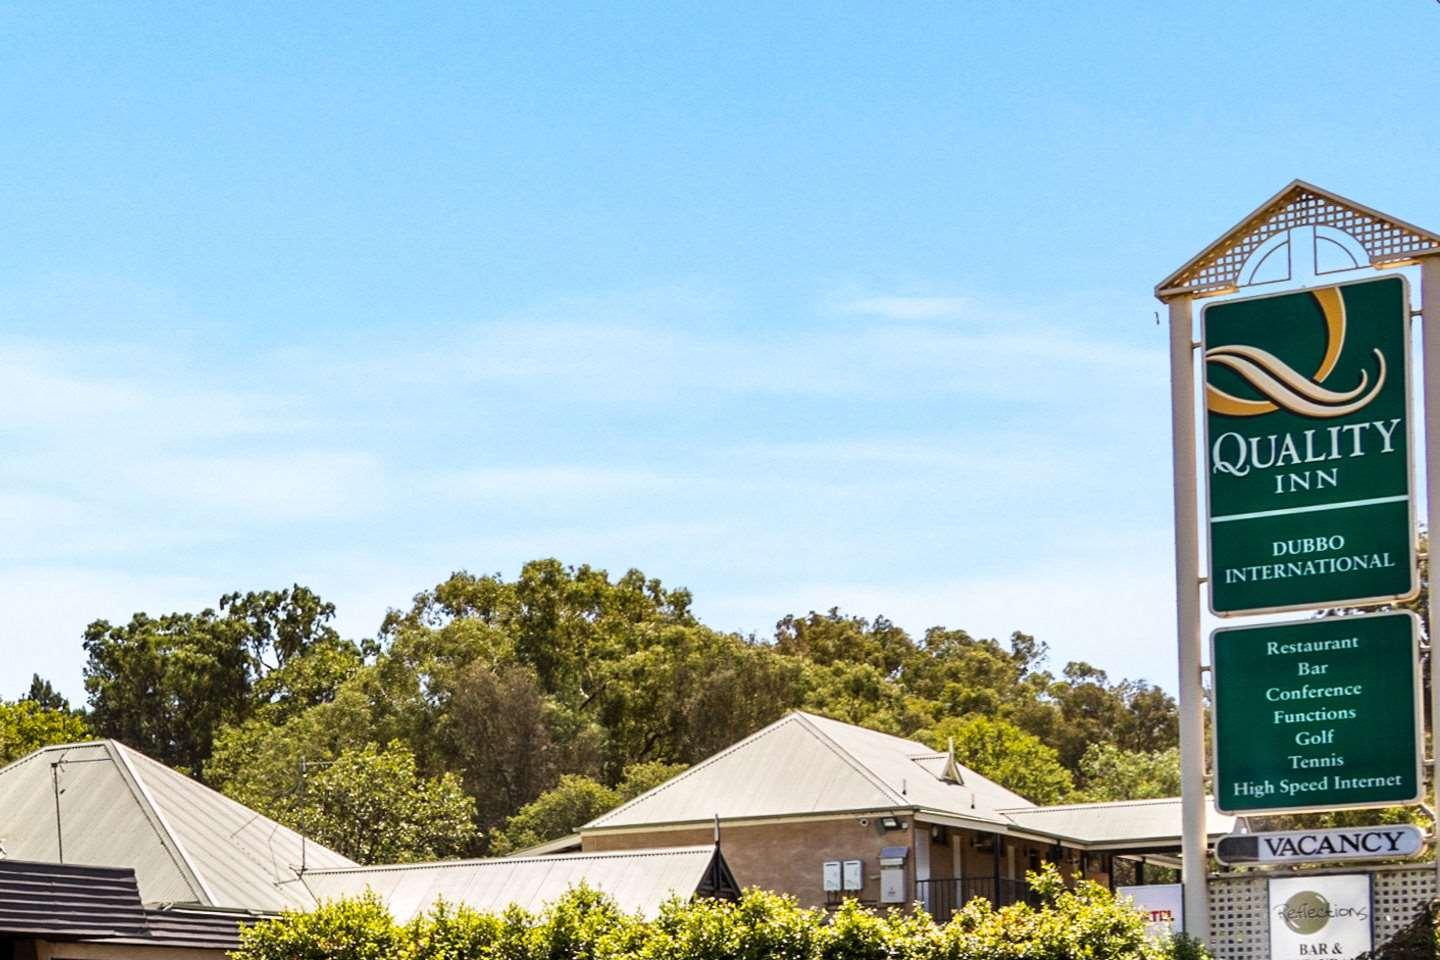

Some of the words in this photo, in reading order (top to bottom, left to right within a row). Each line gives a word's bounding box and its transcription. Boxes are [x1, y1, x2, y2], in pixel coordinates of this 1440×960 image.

[1212, 418, 1402, 477] QUALITY
[1274, 468, 1339, 494] INN
[1272, 535, 1345, 556] DUBBO
[1225, 552, 1395, 584] INTERNATIONAL
[1266, 637, 1359, 656] Restaurant
[1297, 662, 1329, 676] Bar
[1266, 684, 1363, 702] Conference
[1273, 707, 1357, 725] Functions
[1295, 729, 1335, 746] Golf
[1288, 753, 1344, 769] Tennis
[1233, 780, 1275, 798] High
[1279, 776, 1328, 796] Speed
[1334, 775, 1403, 790] Internet
[1264, 831, 1405, 857] VACANCY
[1299, 943, 1328, 956] BAR
[1331, 942, 1343, 955] &
